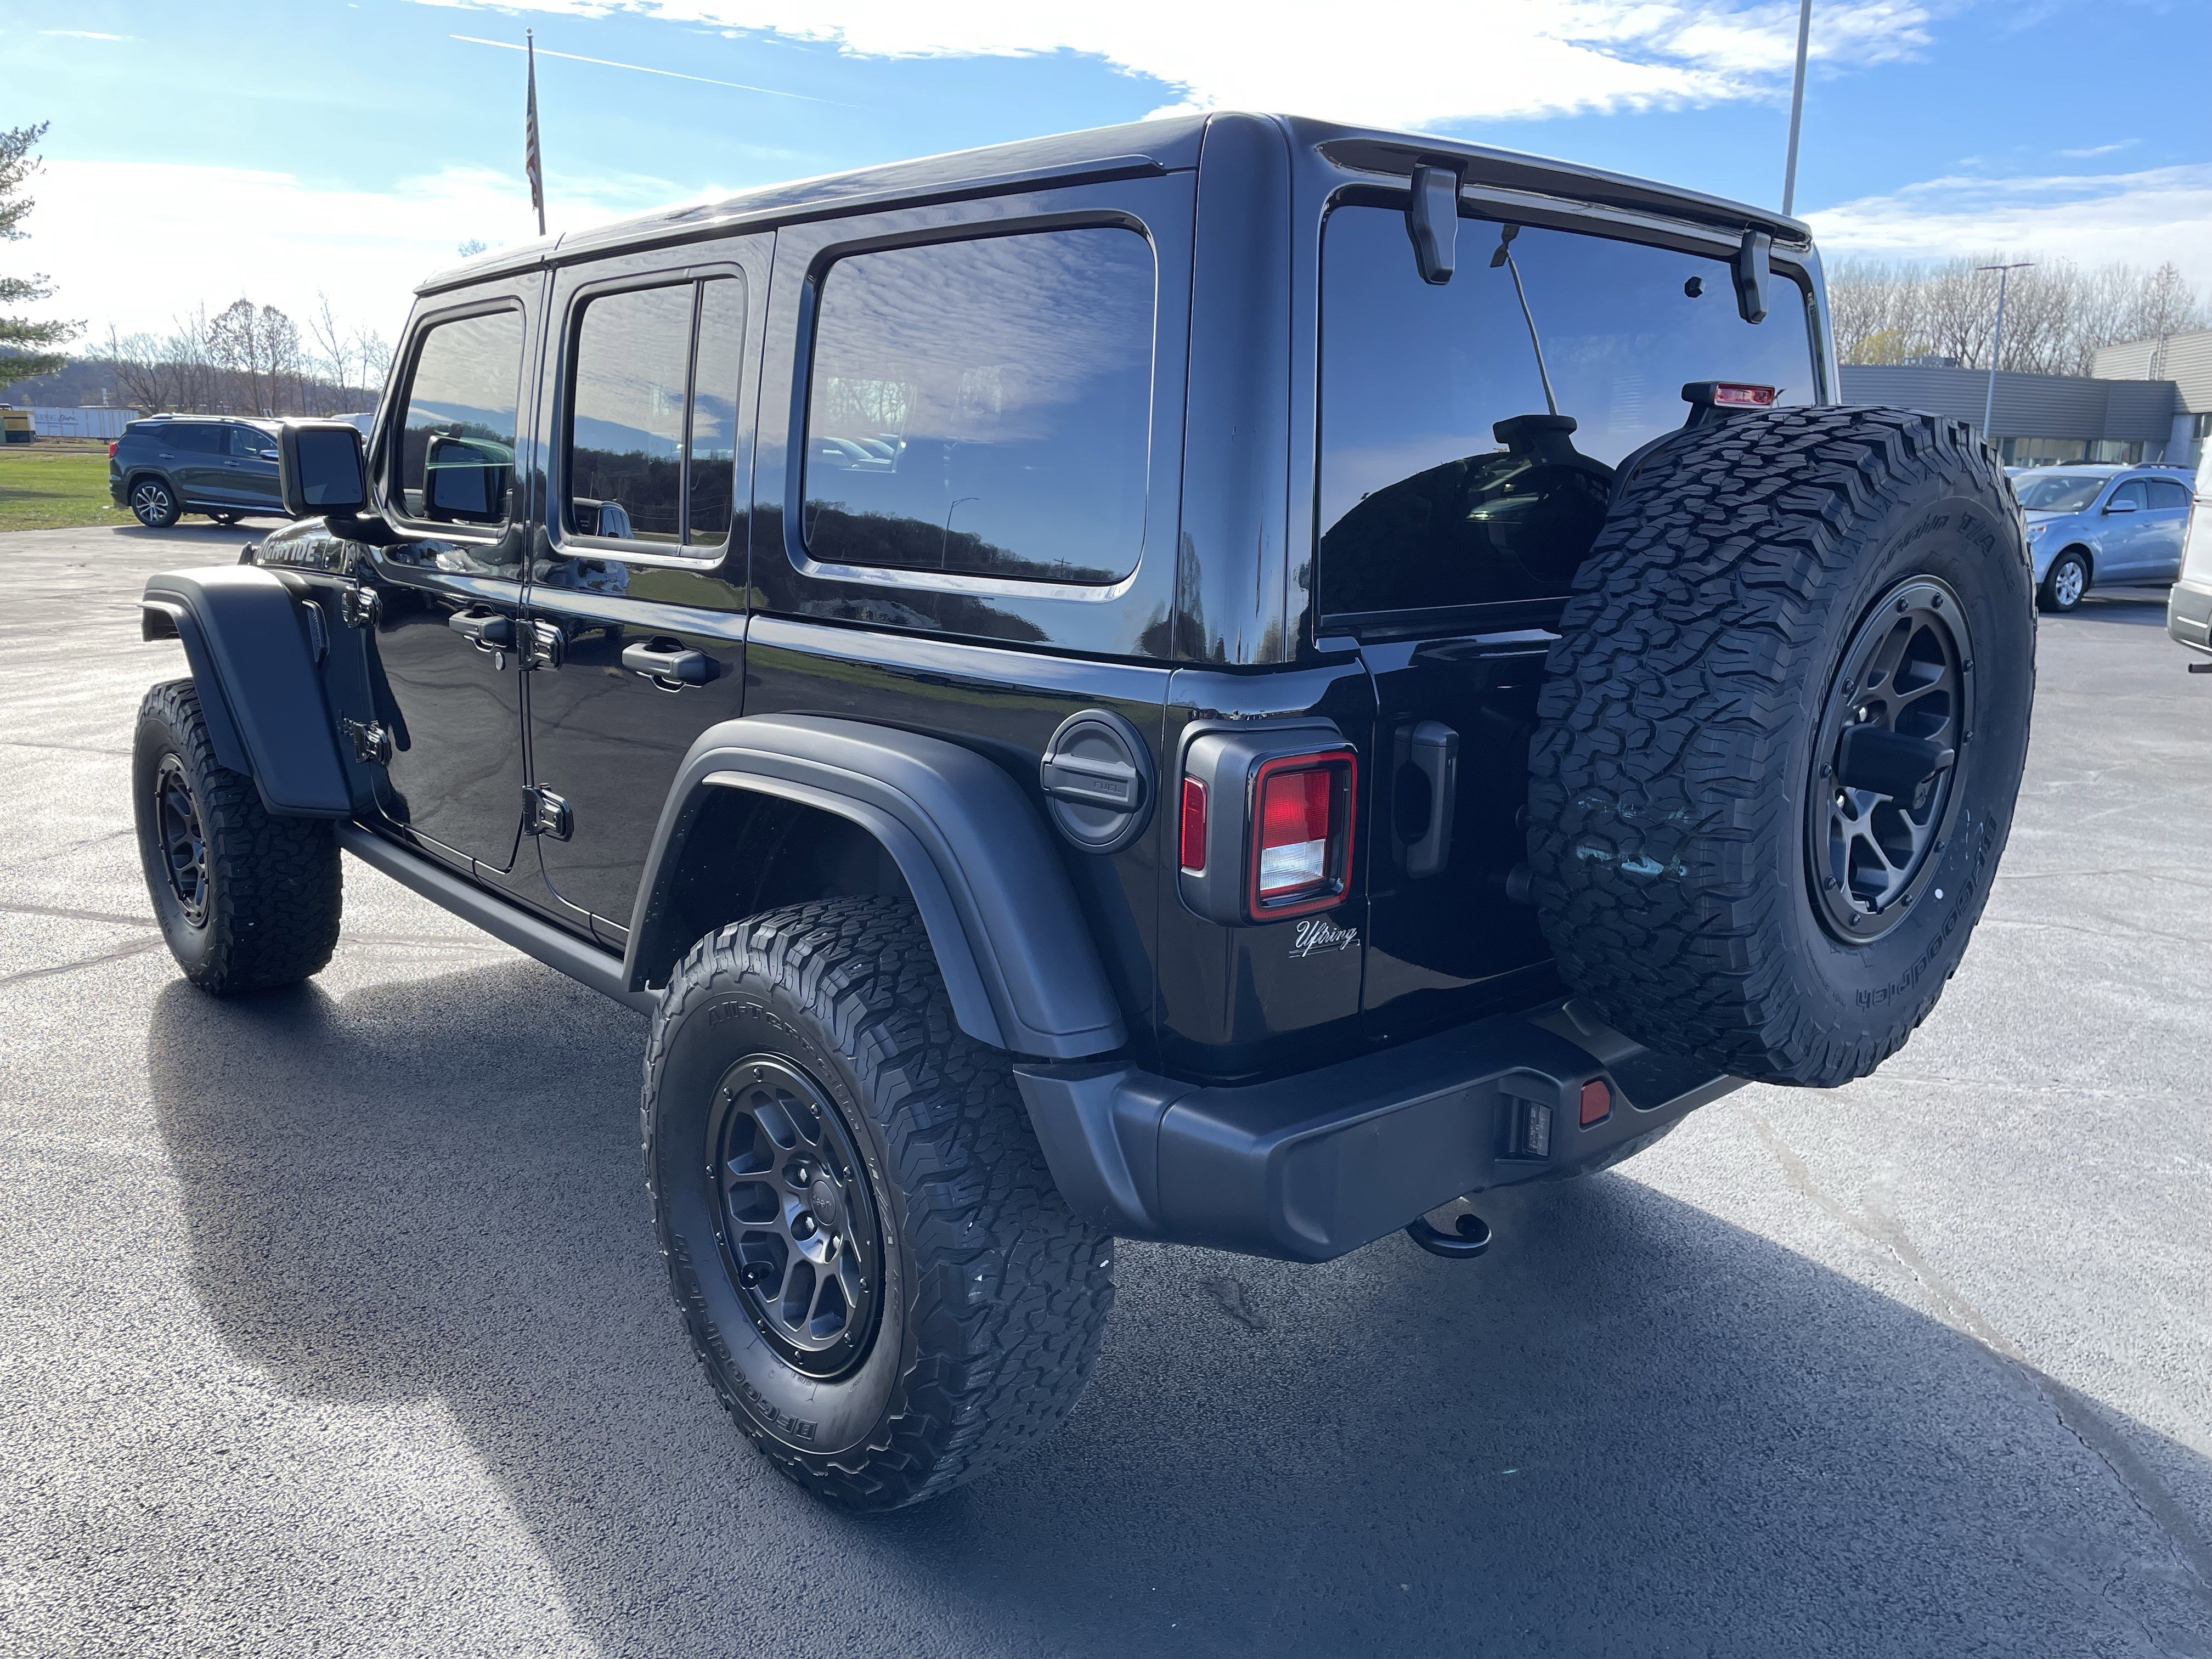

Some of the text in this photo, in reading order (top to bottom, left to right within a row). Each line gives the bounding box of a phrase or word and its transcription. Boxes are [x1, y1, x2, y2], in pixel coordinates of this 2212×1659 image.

[284, 541, 319, 562] TIDE
[1093, 781, 1121, 794] FUEL
[1855, 811, 1997, 1009] BFGoodrich
[1295, 921, 1358, 957] Uftring
[674, 1233, 818, 1443] BFGoodrich
